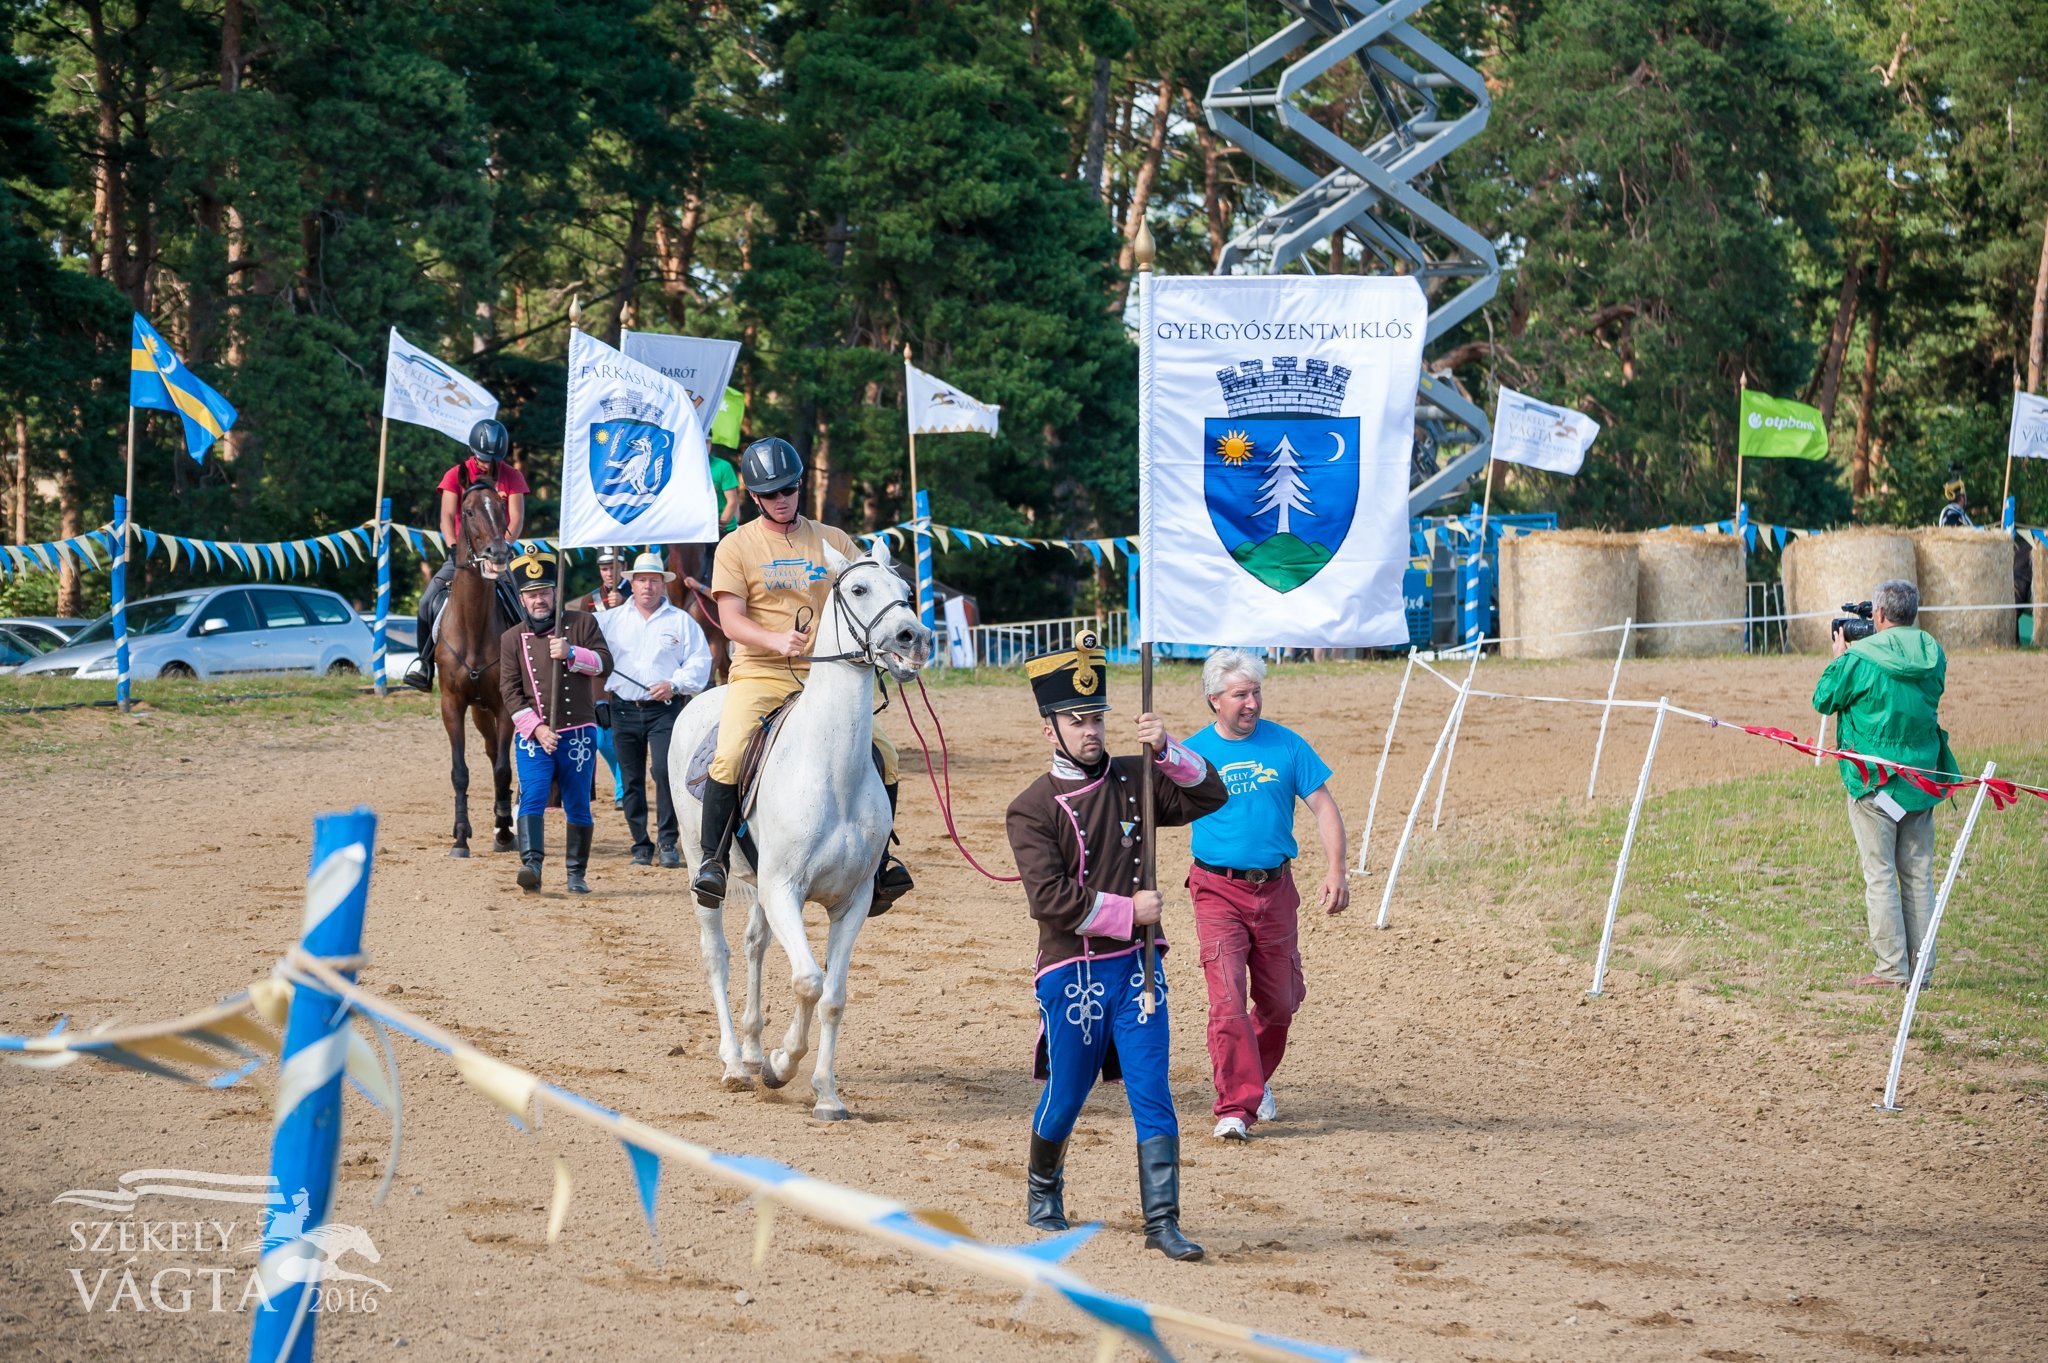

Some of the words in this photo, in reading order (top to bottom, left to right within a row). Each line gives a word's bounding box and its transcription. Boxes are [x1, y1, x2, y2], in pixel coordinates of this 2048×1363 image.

[1157, 318, 1413, 341] GYERGYÓSZENTMIKLÓS
[660, 366, 698, 379] BARÓT
[581, 365, 674, 402] FARKASLAKA
[1227, 780, 1258, 796] GTA
